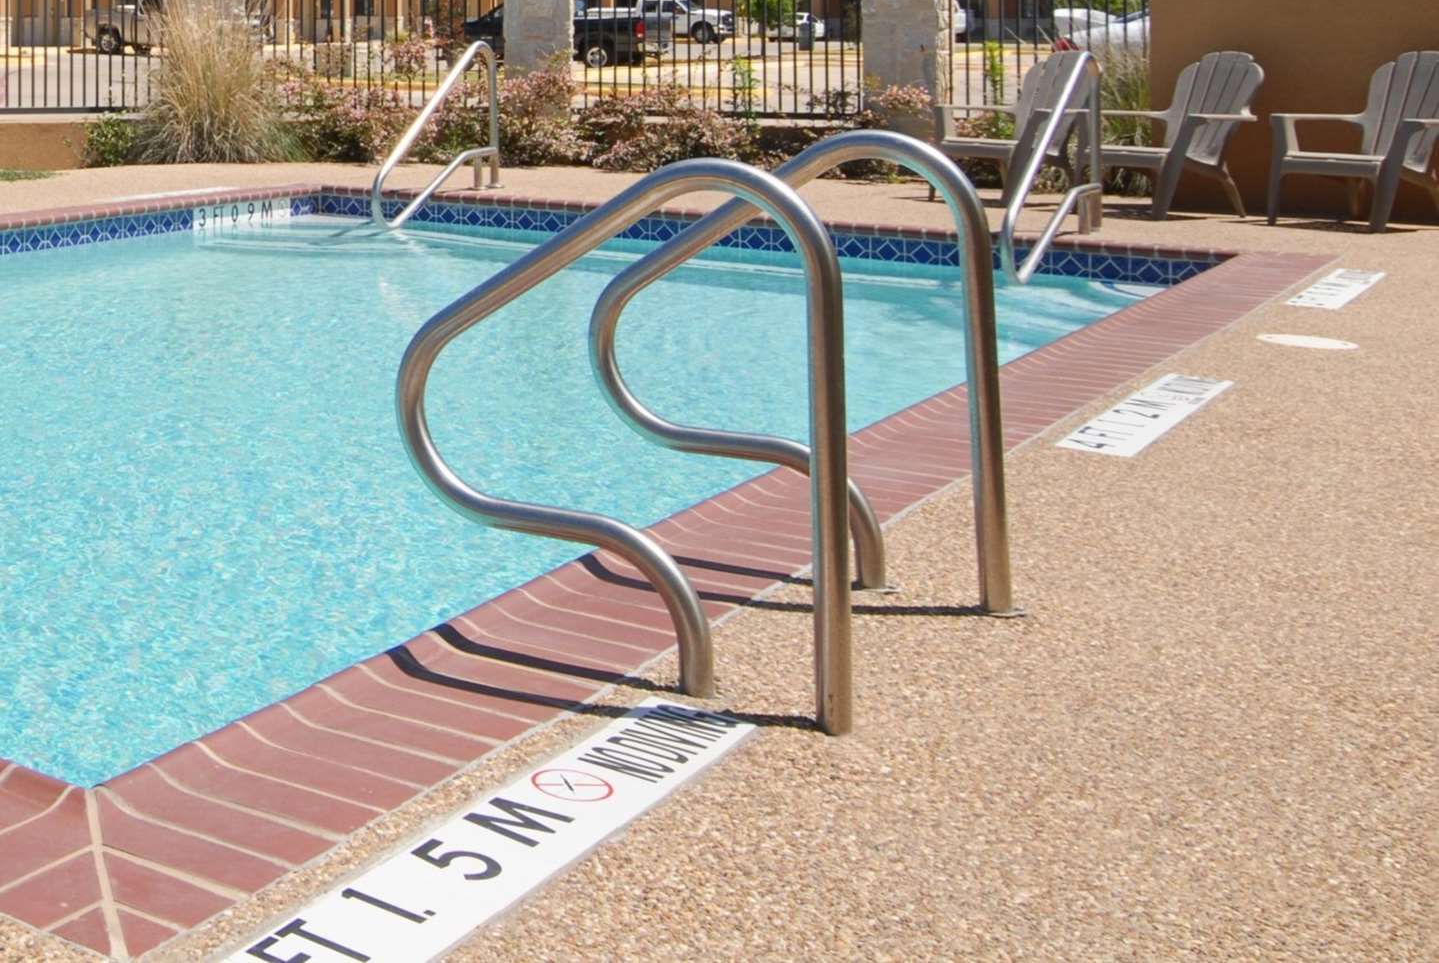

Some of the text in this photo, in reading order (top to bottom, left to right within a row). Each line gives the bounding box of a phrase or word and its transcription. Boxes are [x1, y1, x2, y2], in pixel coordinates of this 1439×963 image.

[198, 208, 207, 227] 3
[213, 205, 225, 224] FT
[261, 200, 273, 219] M
[246, 918, 371, 963] FT
[463, 797, 576, 848] M
